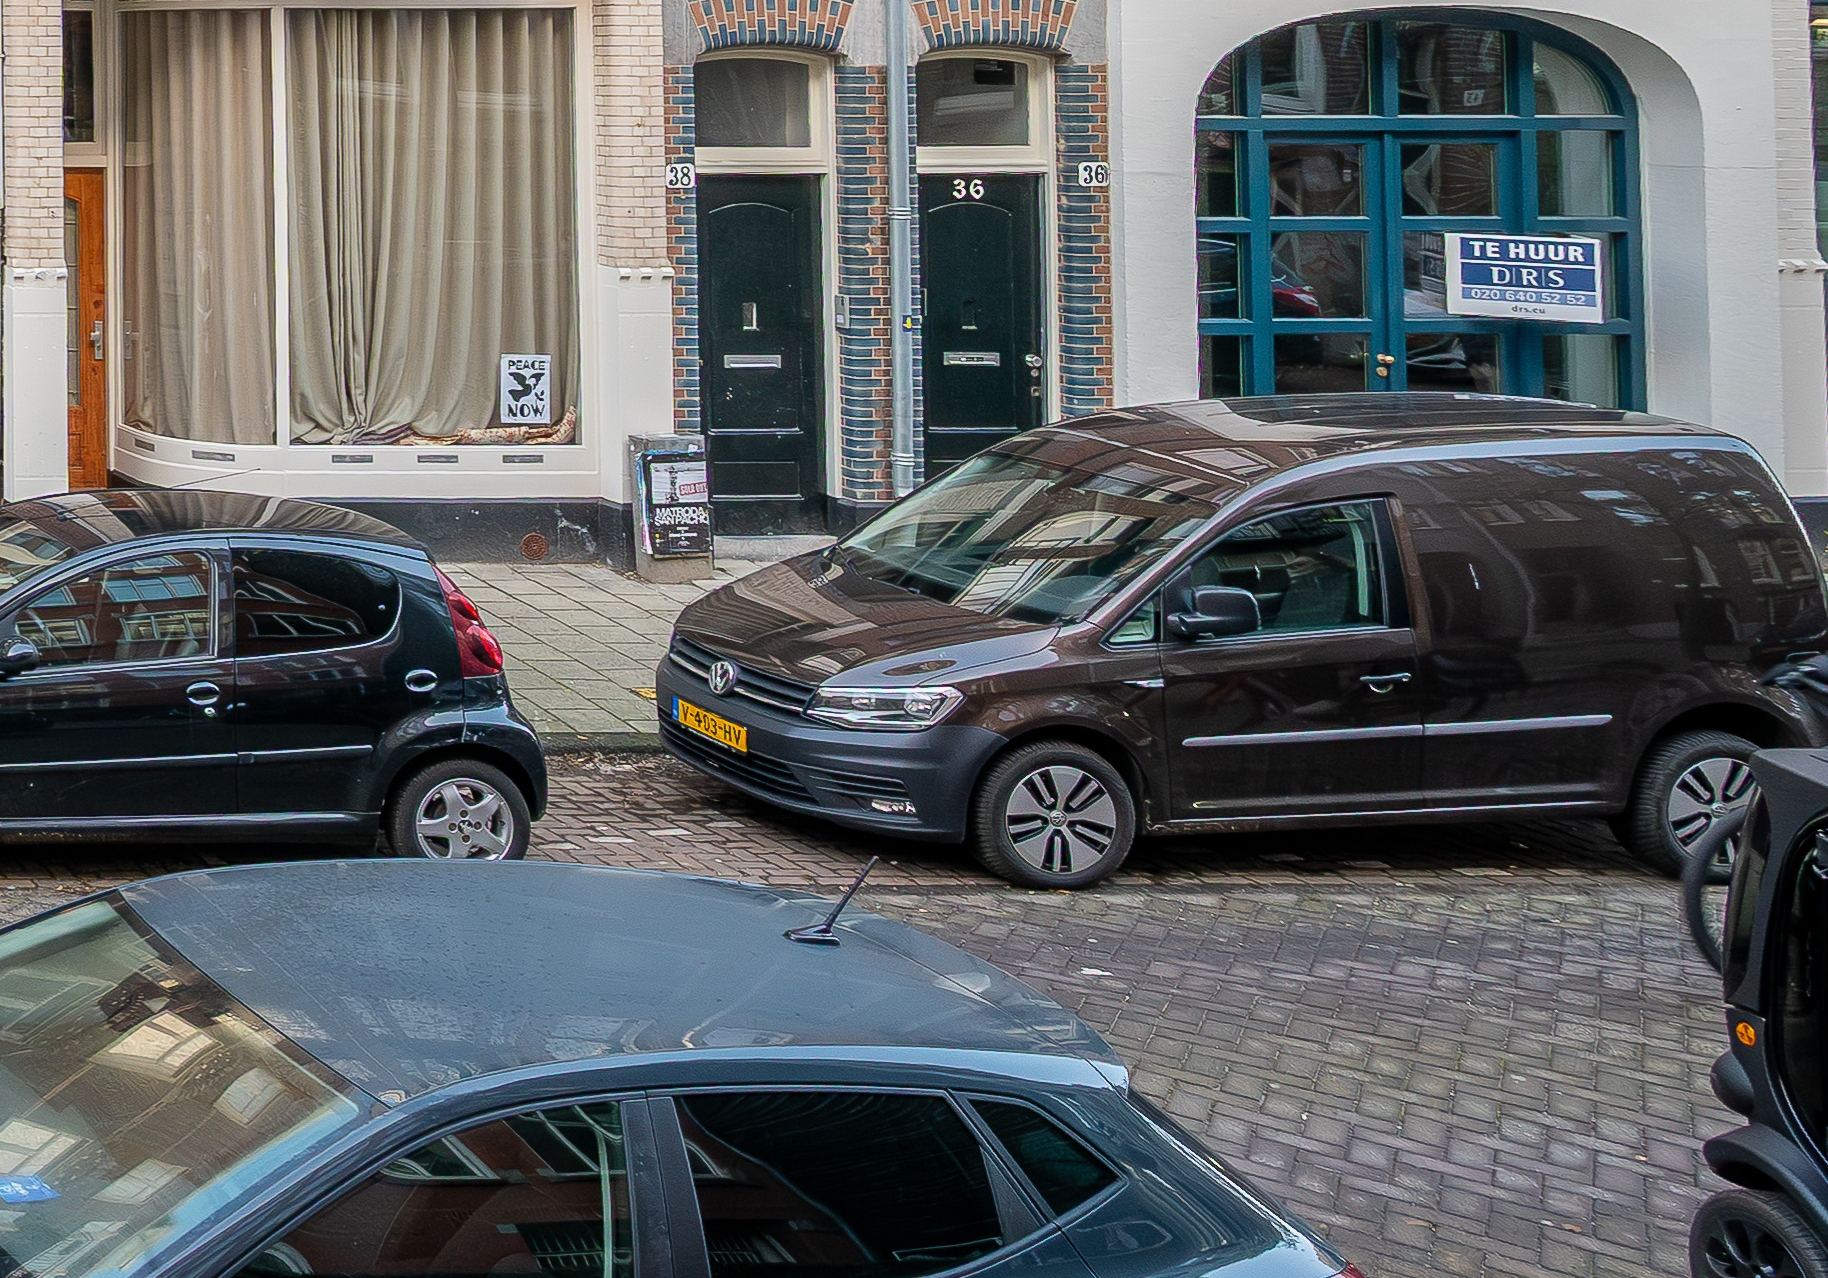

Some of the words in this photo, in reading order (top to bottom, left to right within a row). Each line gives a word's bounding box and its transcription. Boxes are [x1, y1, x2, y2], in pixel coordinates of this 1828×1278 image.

[669, 166, 691, 186] 38
[952, 178, 985, 199] 36
[1469, 241, 1500, 258] TE
[1508, 243, 1585, 262] HUUR
[1471, 288, 1500, 300] 020
[1505, 290, 1536, 302] 640
[1541, 292, 1561, 303] 52
[1566, 294, 1586, 305] 52
[507, 359, 546, 371] PEACE
[507, 403, 545, 418] NOW
[655, 506, 705, 517] MATRODA
[681, 703, 742, 746] V-403-HV
